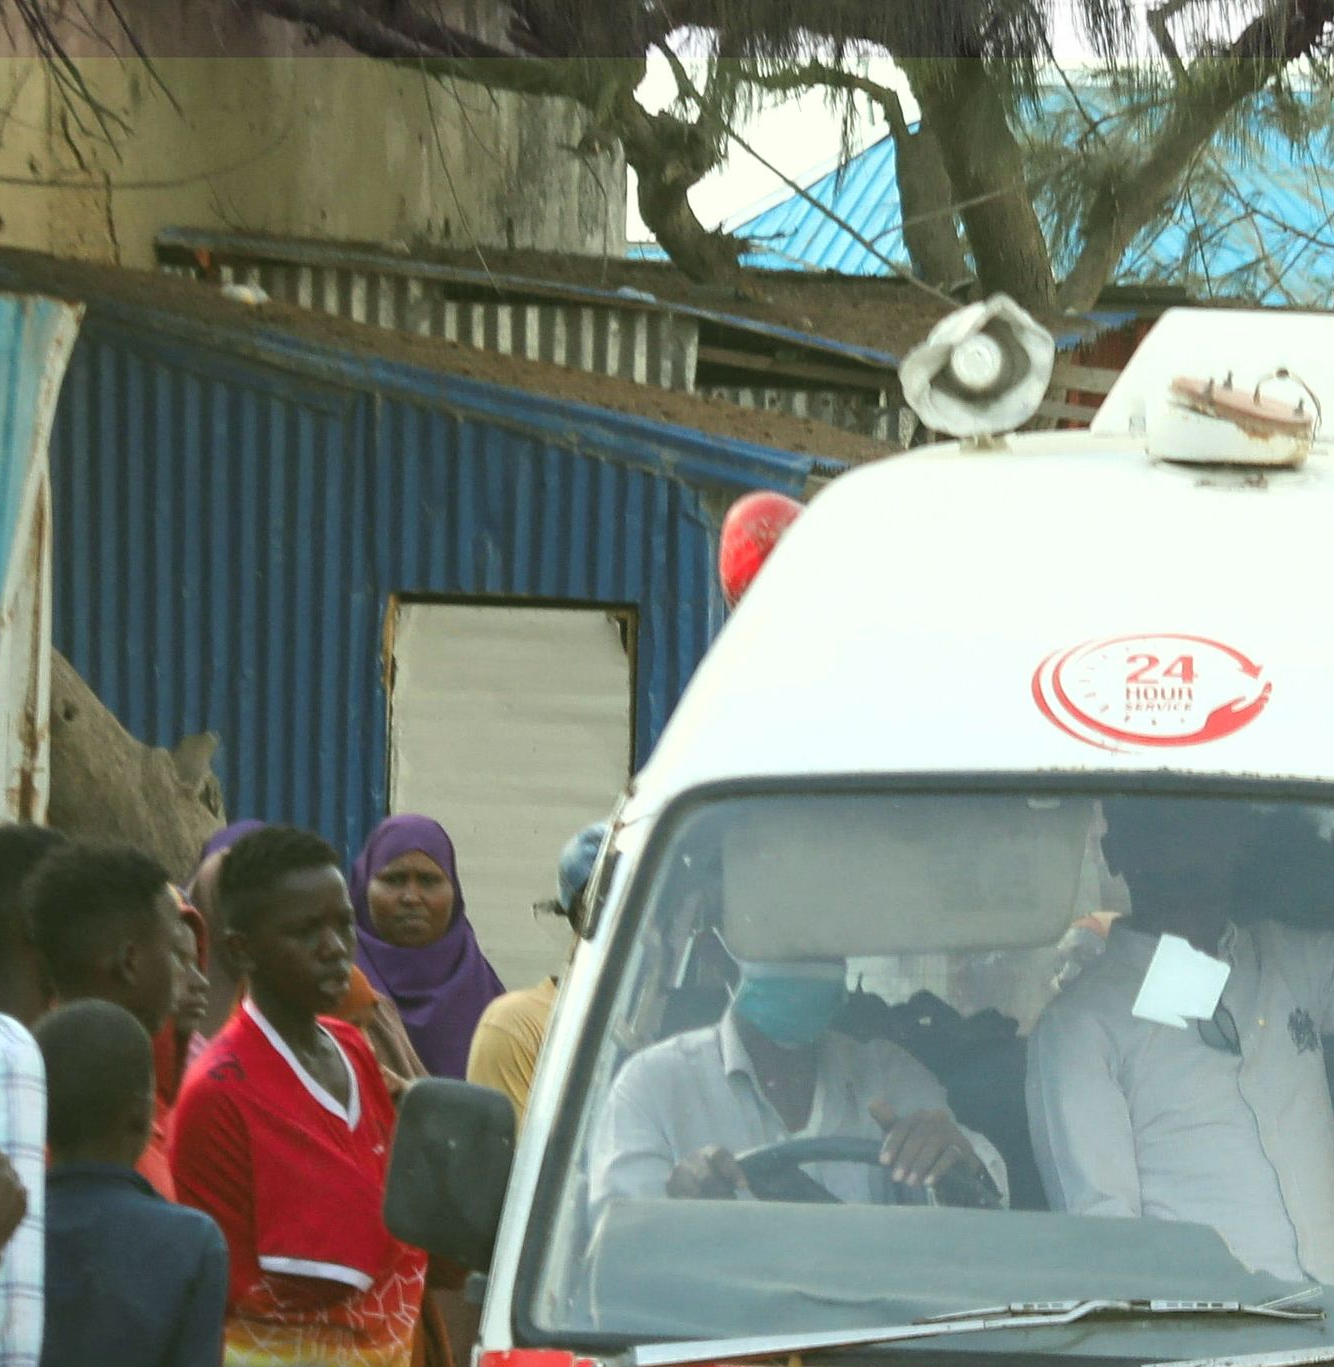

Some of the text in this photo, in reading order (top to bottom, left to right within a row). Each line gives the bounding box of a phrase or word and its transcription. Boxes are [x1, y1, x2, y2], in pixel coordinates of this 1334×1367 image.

[1125, 653, 1198, 684] 24
[1125, 686, 1194, 701] HOUR
[1124, 702, 1193, 712] SERVICE
